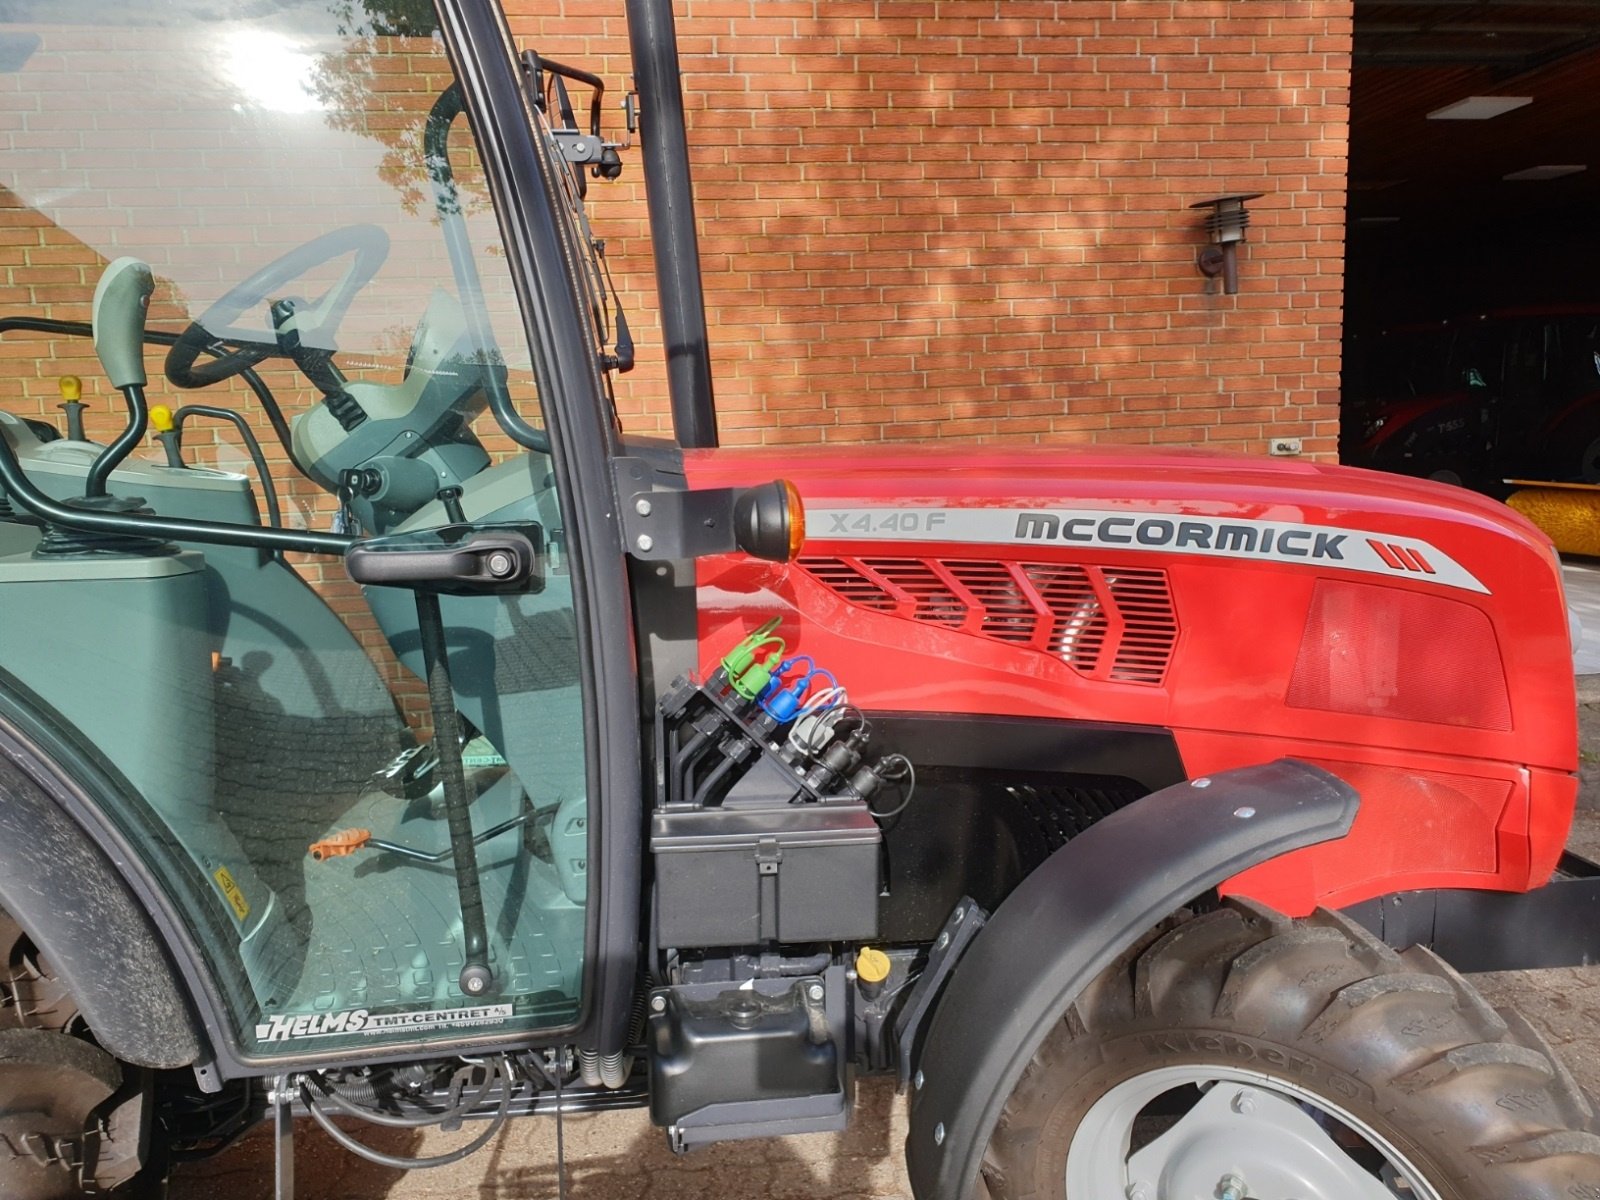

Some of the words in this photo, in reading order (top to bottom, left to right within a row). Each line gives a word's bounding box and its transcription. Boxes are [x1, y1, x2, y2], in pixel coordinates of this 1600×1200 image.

[267, 1009, 369, 1041] HELMS
[373, 1008, 491, 1027] TMT-CENTRET
[1140, 1034, 1317, 1074] Kleber
